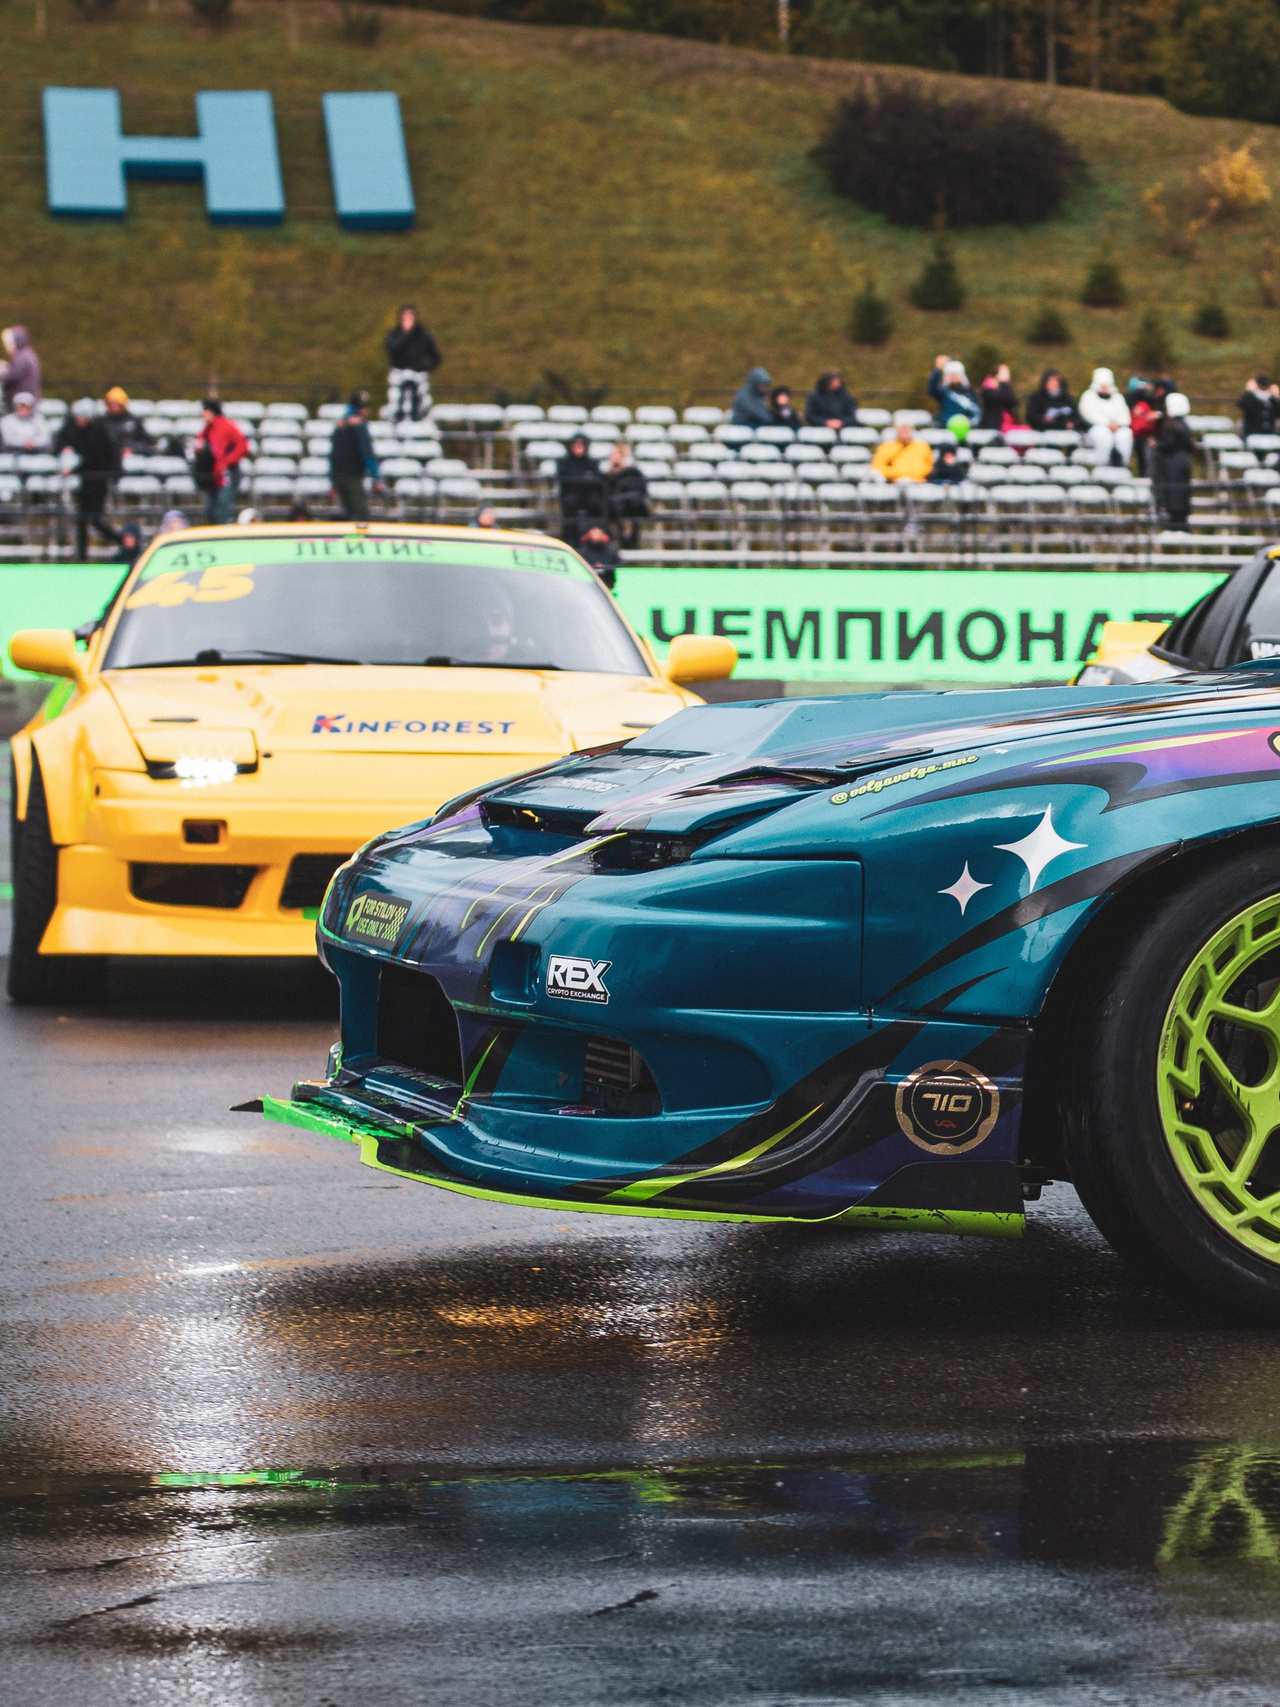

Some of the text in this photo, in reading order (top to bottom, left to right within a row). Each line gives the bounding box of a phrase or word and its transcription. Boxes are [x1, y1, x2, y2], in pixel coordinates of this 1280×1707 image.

[171, 551, 217, 567] 45
[124, 563, 256, 610] 45
[652, 608, 1180, 662] ЧЕМПИОНА
[311, 714, 516, 734] KINFOREST
[363, 898, 378, 916] FOR
[547, 956, 607, 992] REX
[547, 987, 606, 1001] CRYPTO EXCHANGE
